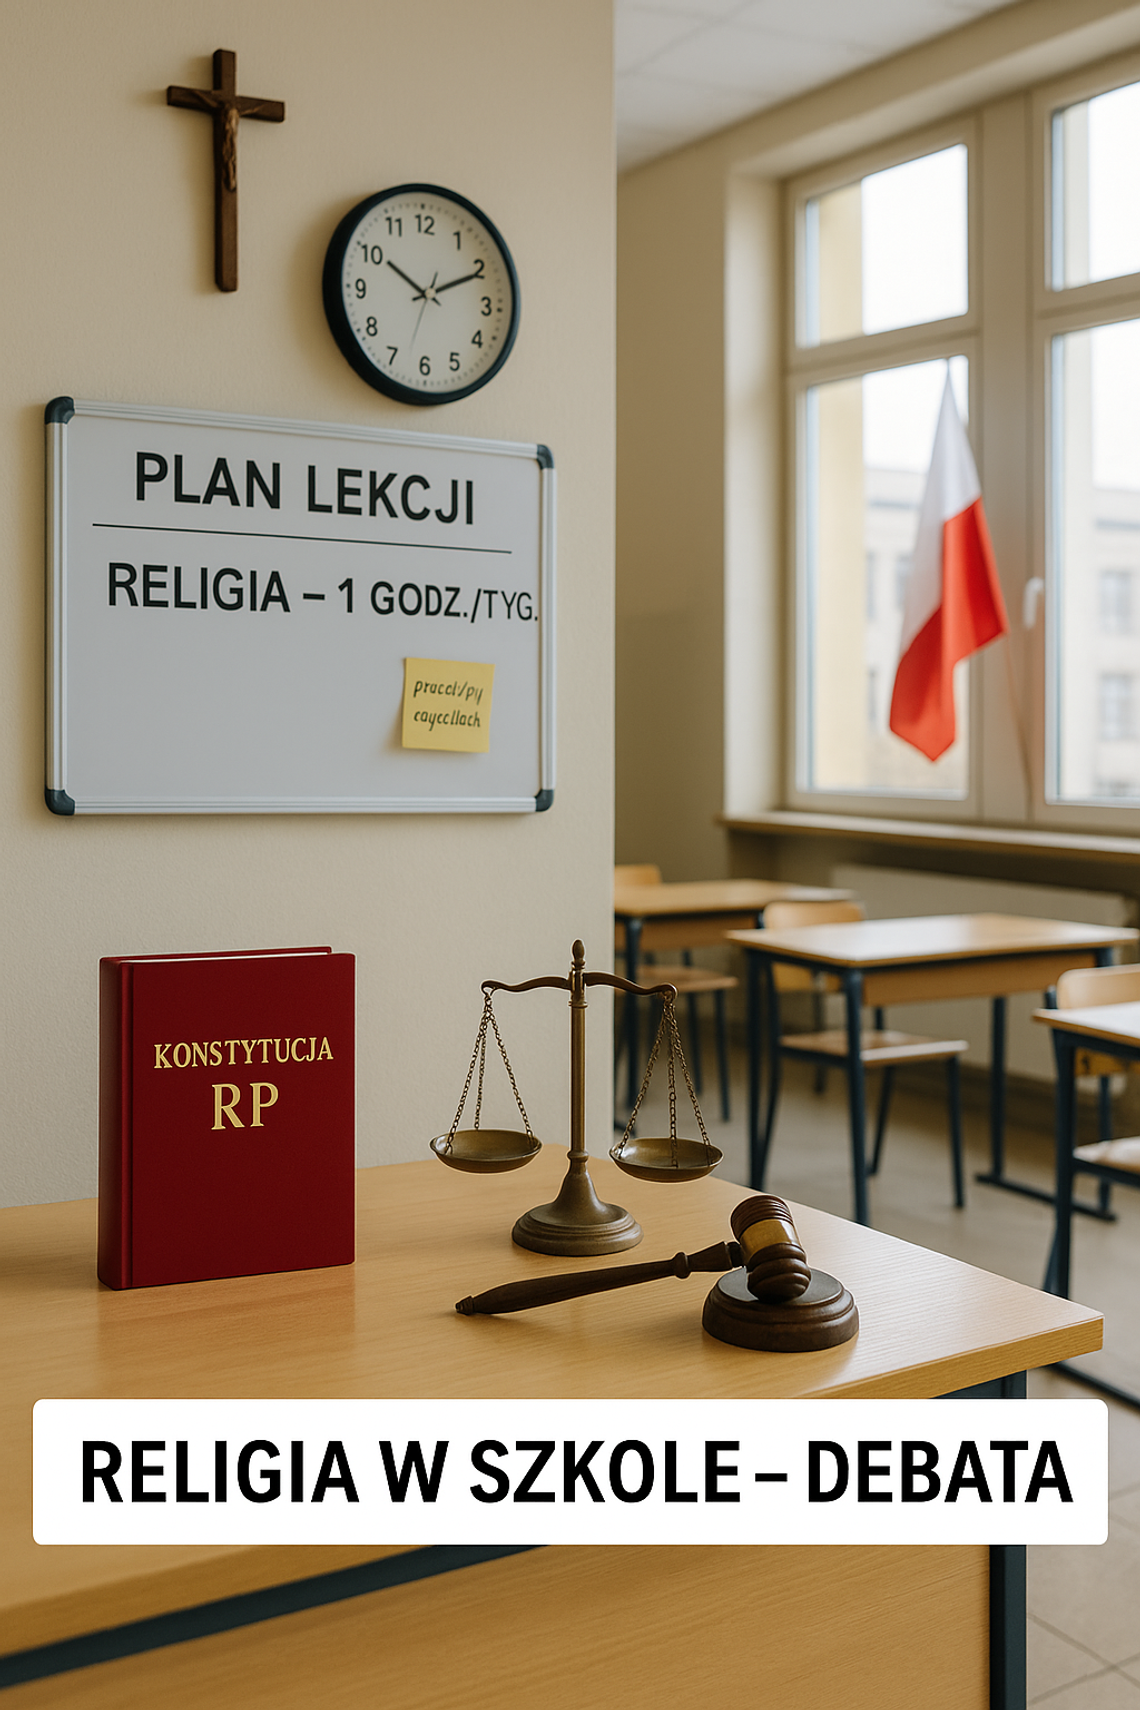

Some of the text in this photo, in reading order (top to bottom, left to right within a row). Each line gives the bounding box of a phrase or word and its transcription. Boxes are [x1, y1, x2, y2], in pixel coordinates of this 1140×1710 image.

[385, 217, 402, 237] 11
[415, 214, 435, 236] 12
[453, 231, 461, 250] 1
[361, 245, 383, 265] 10
[474, 259, 485, 279] 2
[355, 278, 367, 299] 9
[481, 296, 492, 316] 3
[366, 316, 378, 337] 8
[471, 330, 483, 349] 4
[386, 346, 398, 365] 7
[419, 356, 431, 375] 6
[449, 352, 460, 371] 5
[136, 451, 474, 525] PLAN LEKCJI
[108, 562, 291, 613] RELIGIA
[337, 577, 353, 614] 1
[370, 580, 539, 624] GODZ./TYG.
[153, 1036, 334, 1069] KONSTYTUCJA
[210, 1082, 279, 1131] RP
